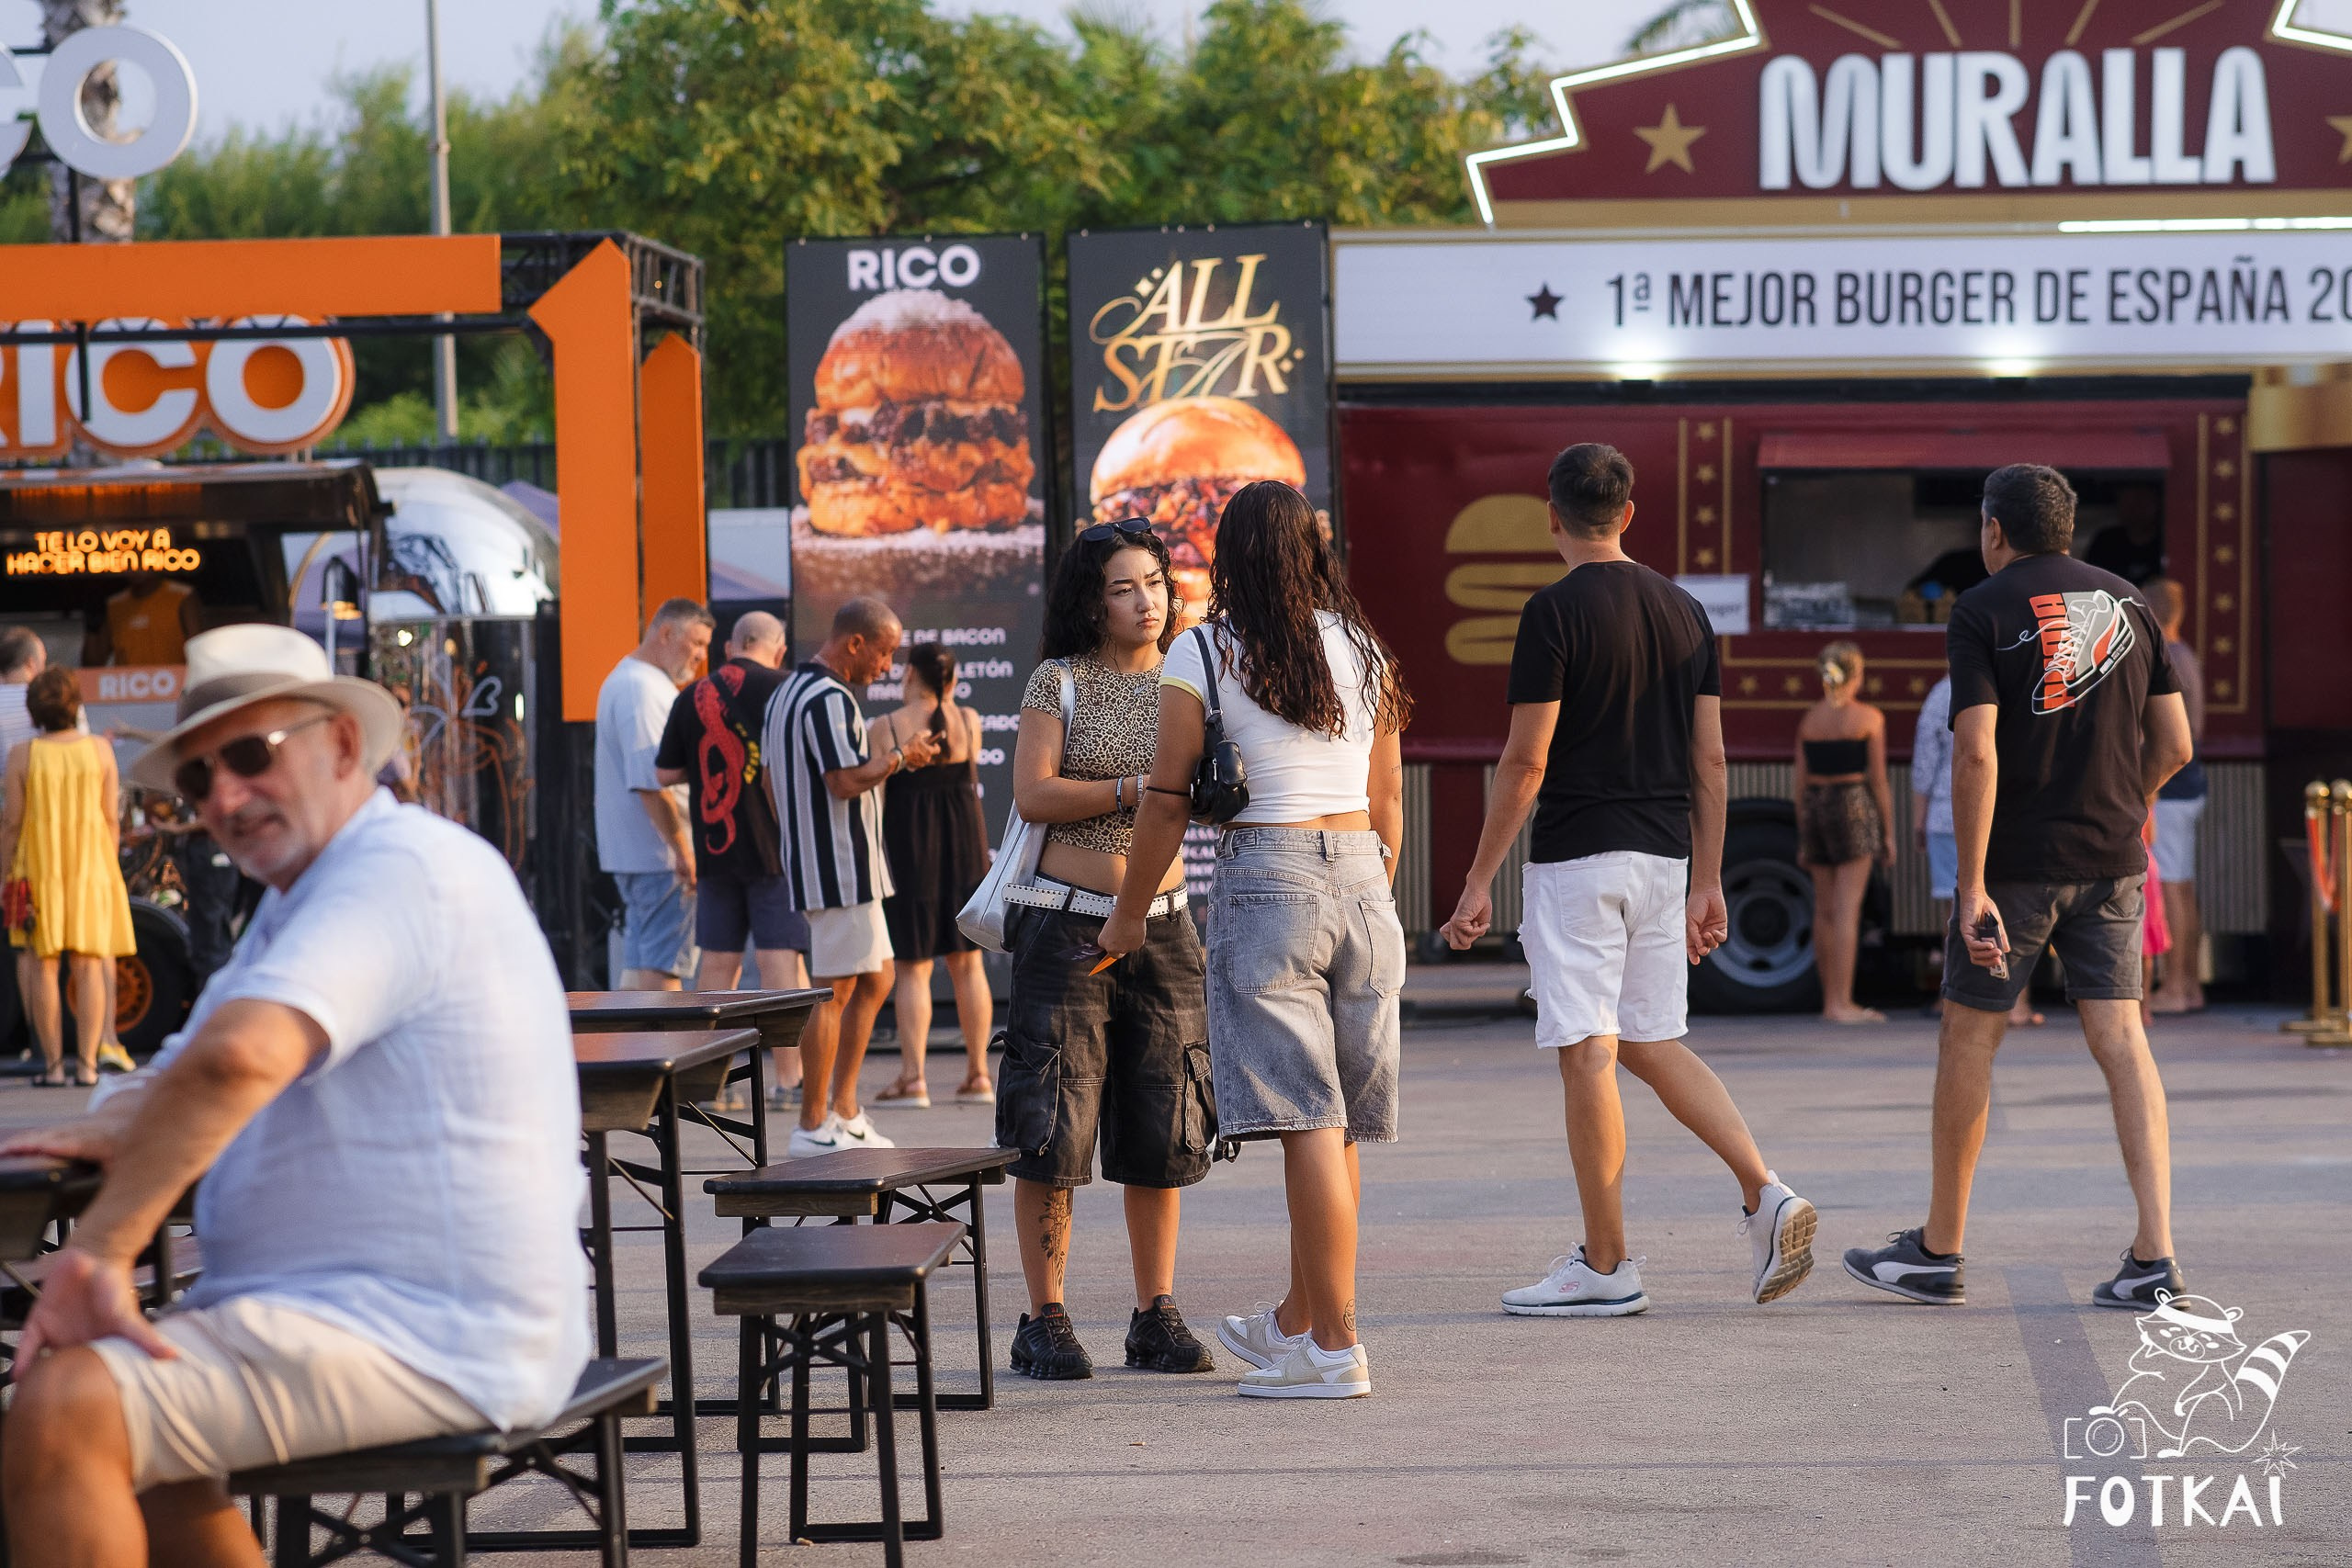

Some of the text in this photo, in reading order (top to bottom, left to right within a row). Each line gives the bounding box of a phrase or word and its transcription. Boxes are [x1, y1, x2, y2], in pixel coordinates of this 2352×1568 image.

[1758, 46, 2276, 190] MURALLA
[847, 243, 981, 290] RICO
[1089, 254, 1281, 344] ALL
[1668, 271, 1816, 327] MEJOR
[1836, 270, 2016, 325] BURGER
[2035, 270, 2091, 324] DE
[2107, 254, 2291, 324] ESPAÑA
[6, 551, 85, 575] HACER
[141, 548, 200, 572] RICO
[35, 528, 171, 553] TE LO VOY A
[99, 671, 175, 699] RICO
